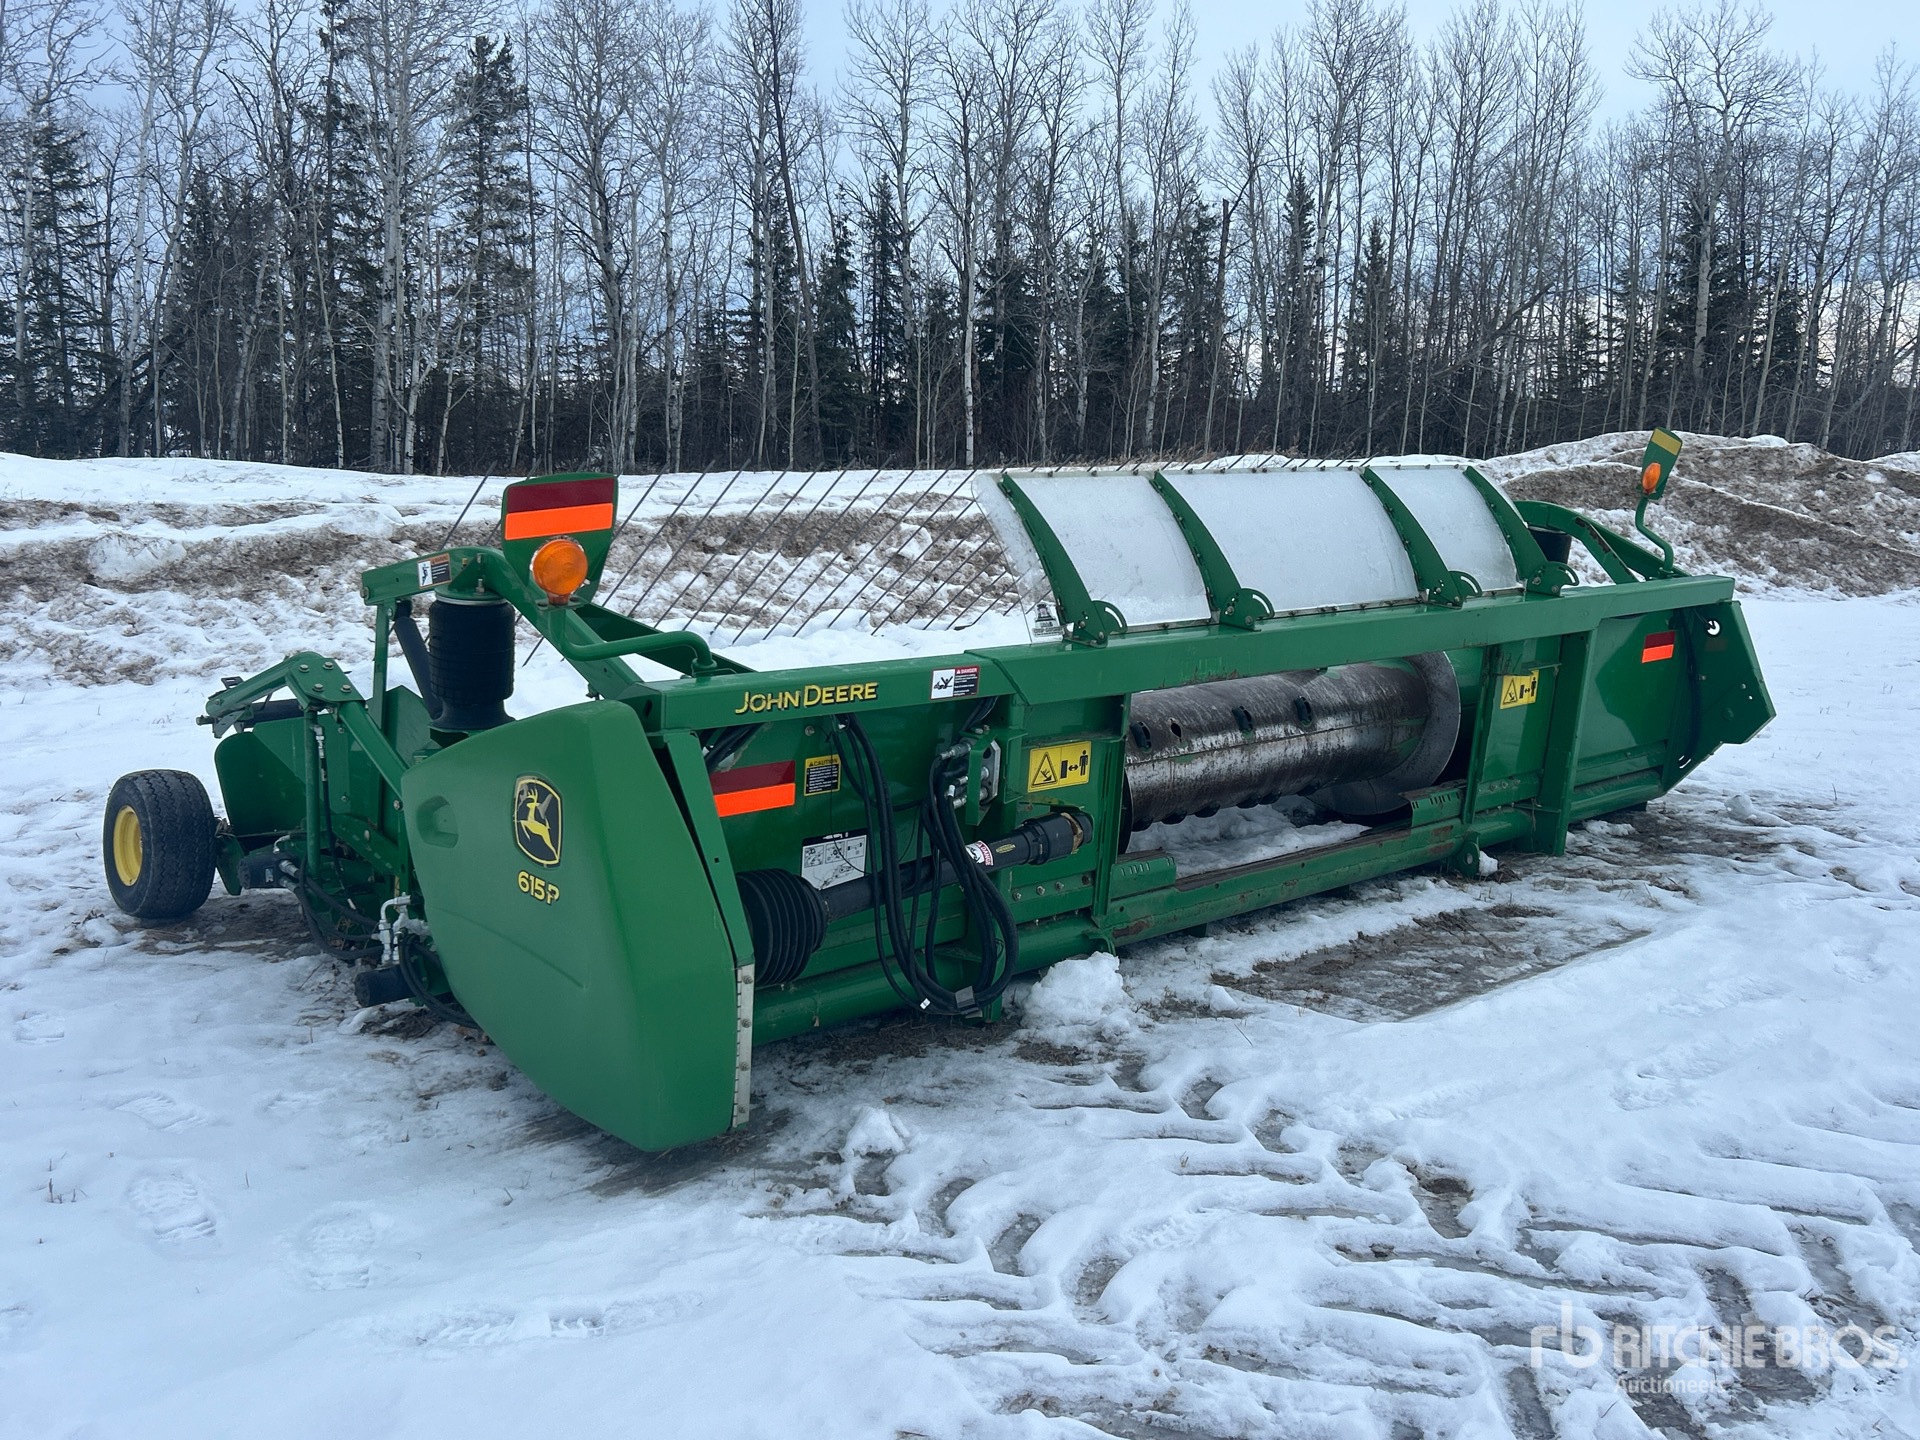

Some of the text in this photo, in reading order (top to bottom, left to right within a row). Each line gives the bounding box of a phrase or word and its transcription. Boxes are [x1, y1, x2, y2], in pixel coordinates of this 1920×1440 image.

[735, 682, 878, 714] JOHN DEERE
[518, 871, 560, 904] 615P
